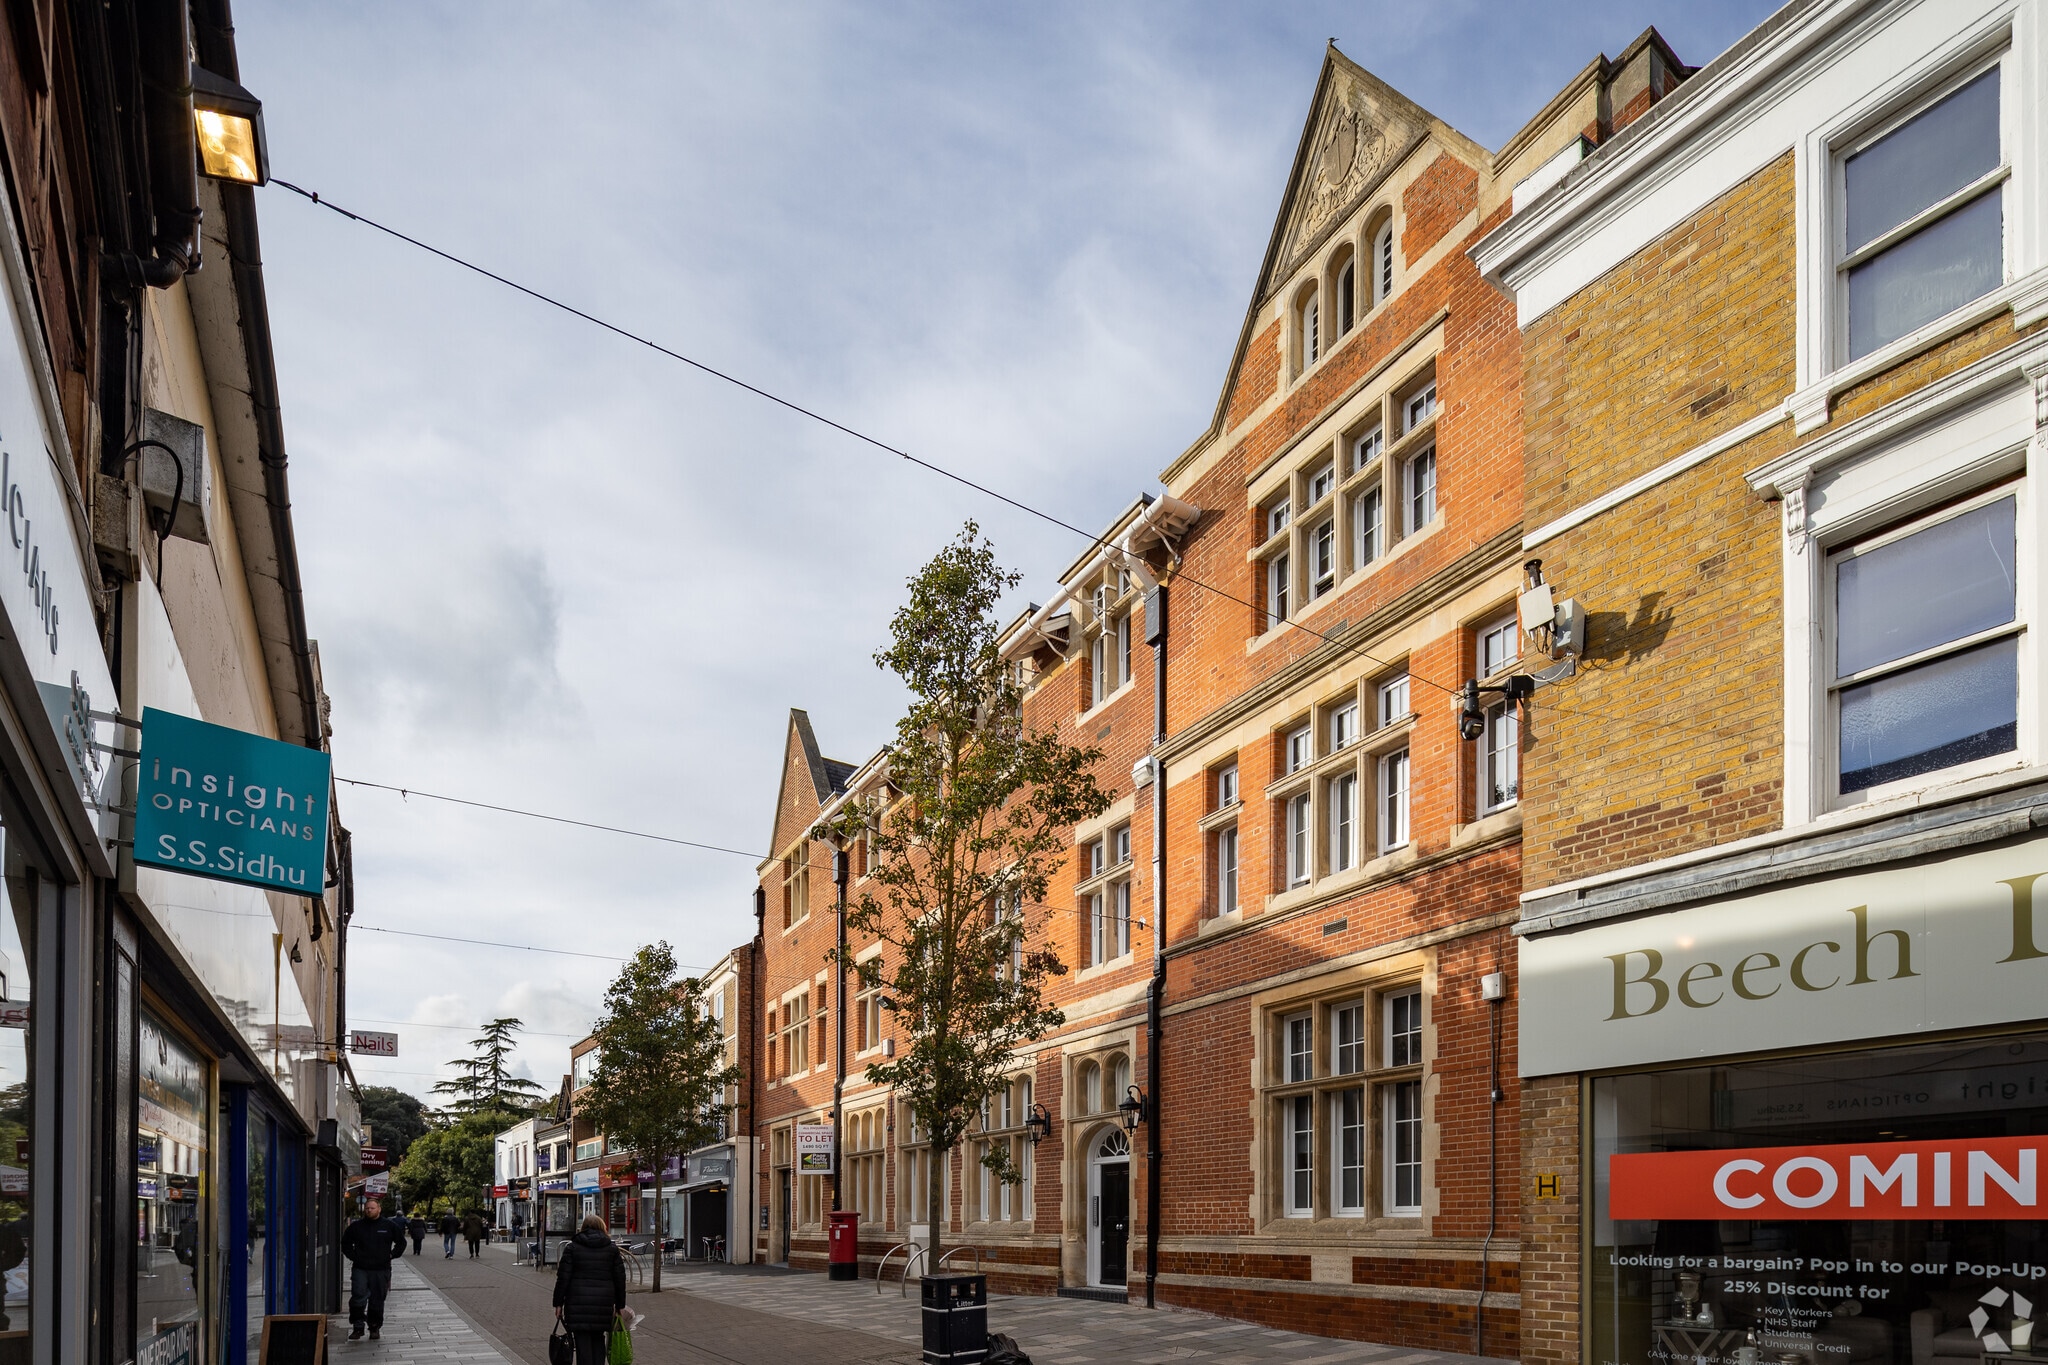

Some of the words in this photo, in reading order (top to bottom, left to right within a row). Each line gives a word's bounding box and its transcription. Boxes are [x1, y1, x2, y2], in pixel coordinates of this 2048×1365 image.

[0, 431, 60, 656] ICIANS
[152, 757, 316, 815] insight
[152, 793, 314, 841] OPTICIANS
[157, 834, 306, 885] S.S.Sidhu
[1602, 904, 1922, 1022] Beech
[355, 1034, 394, 1052] Nails
[362, 1152, 376, 1160] Dry
[1538, 1175, 1557, 1197] H
[1712, 1148, 2038, 1210] COMIN
[1609, 1254, 1674, 1269] Looking
[1678, 1254, 1703, 1268] for
[1707, 1259, 1718, 1268] a
[1723, 1256, 1804, 1271] bargain?
[1810, 1258, 1849, 1274] Pop
[1856, 1258, 1874, 1272] in
[1880, 1259, 1904, 1273] to
[1910, 1263, 1948, 1275] our
[1955, 1261, 2047, 1280] Pop-Up
[1723, 1280, 1761, 1294] 25%
[1766, 1281, 1853, 1298] Discount
[1859, 1285, 1890, 1299] for
[956, 1300, 975, 1308] Litter
[1764, 1306, 1785, 1316] Key
[1788, 1307, 1833, 1318] Workers
[1764, 1317, 1788, 1327] NHS
[1791, 1318, 1818, 1328] Staff
[1764, 1328, 1813, 1339] Students
[1764, 1339, 1814, 1351] Universal
[1816, 1343, 1851, 1354] Credit
[1673, 1353, 1689, 1362] one
